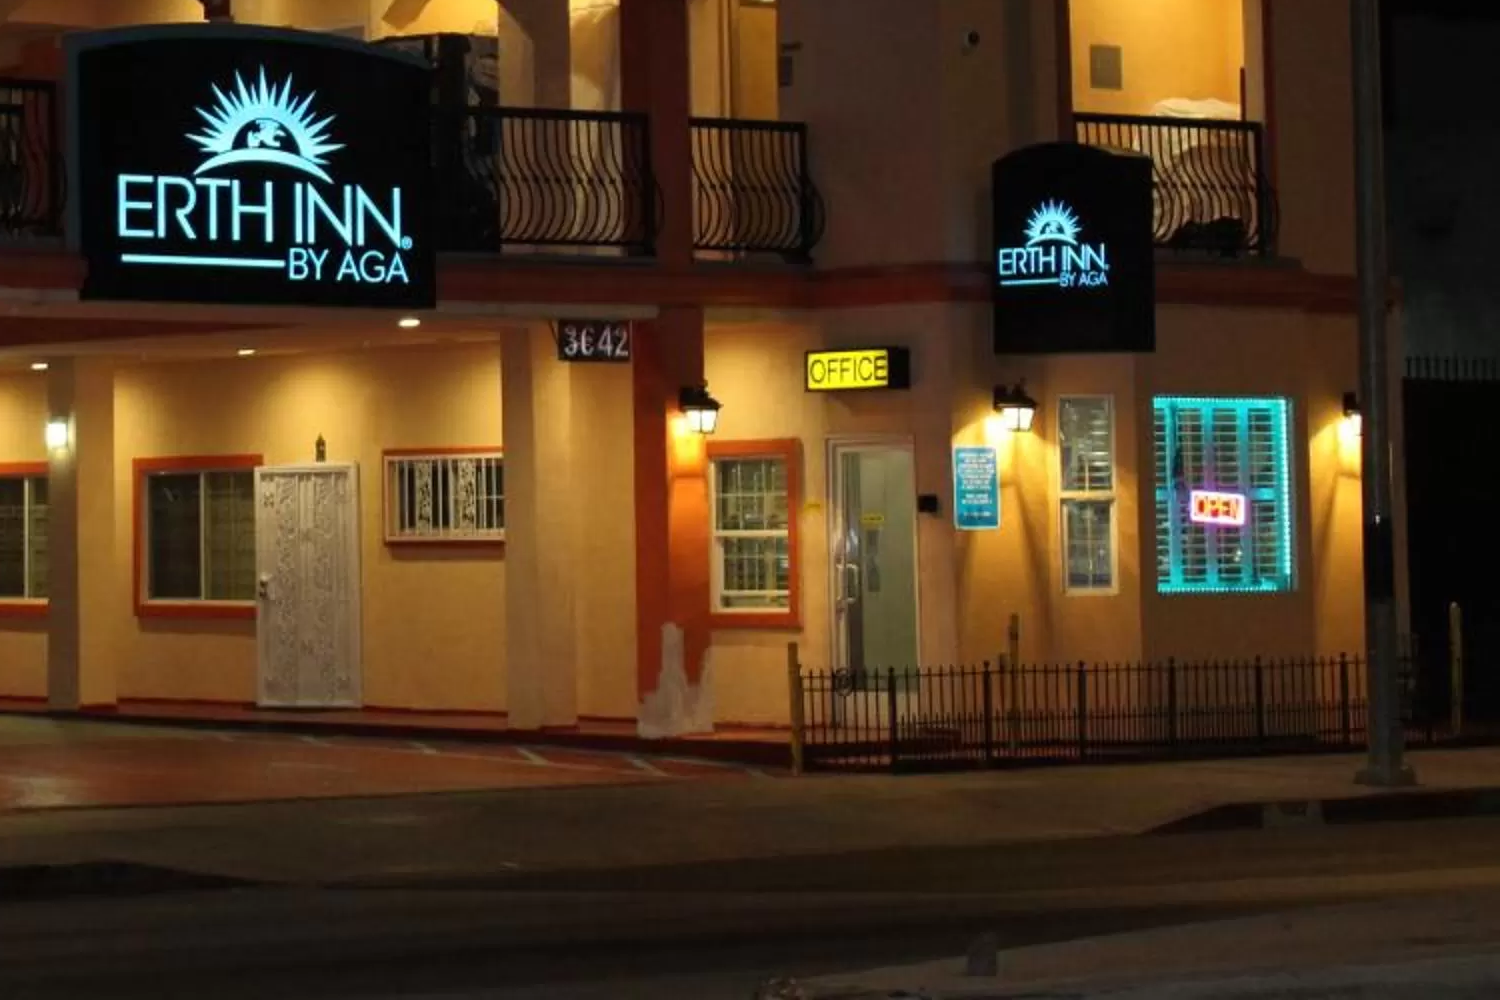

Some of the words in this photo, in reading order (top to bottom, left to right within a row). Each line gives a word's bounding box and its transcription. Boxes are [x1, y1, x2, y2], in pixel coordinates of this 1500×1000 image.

[117, 173, 274, 243] ERTH
[288, 247, 329, 281] BY
[335, 250, 409, 284] AGA
[998, 245, 1056, 275] ERTH
[1059, 271, 1077, 287] BY
[1078, 270, 1109, 287] AGA
[564, 324, 629, 357] 3642
[809, 355, 887, 385] OFFICE
[1194, 495, 1241, 521] OPEN
